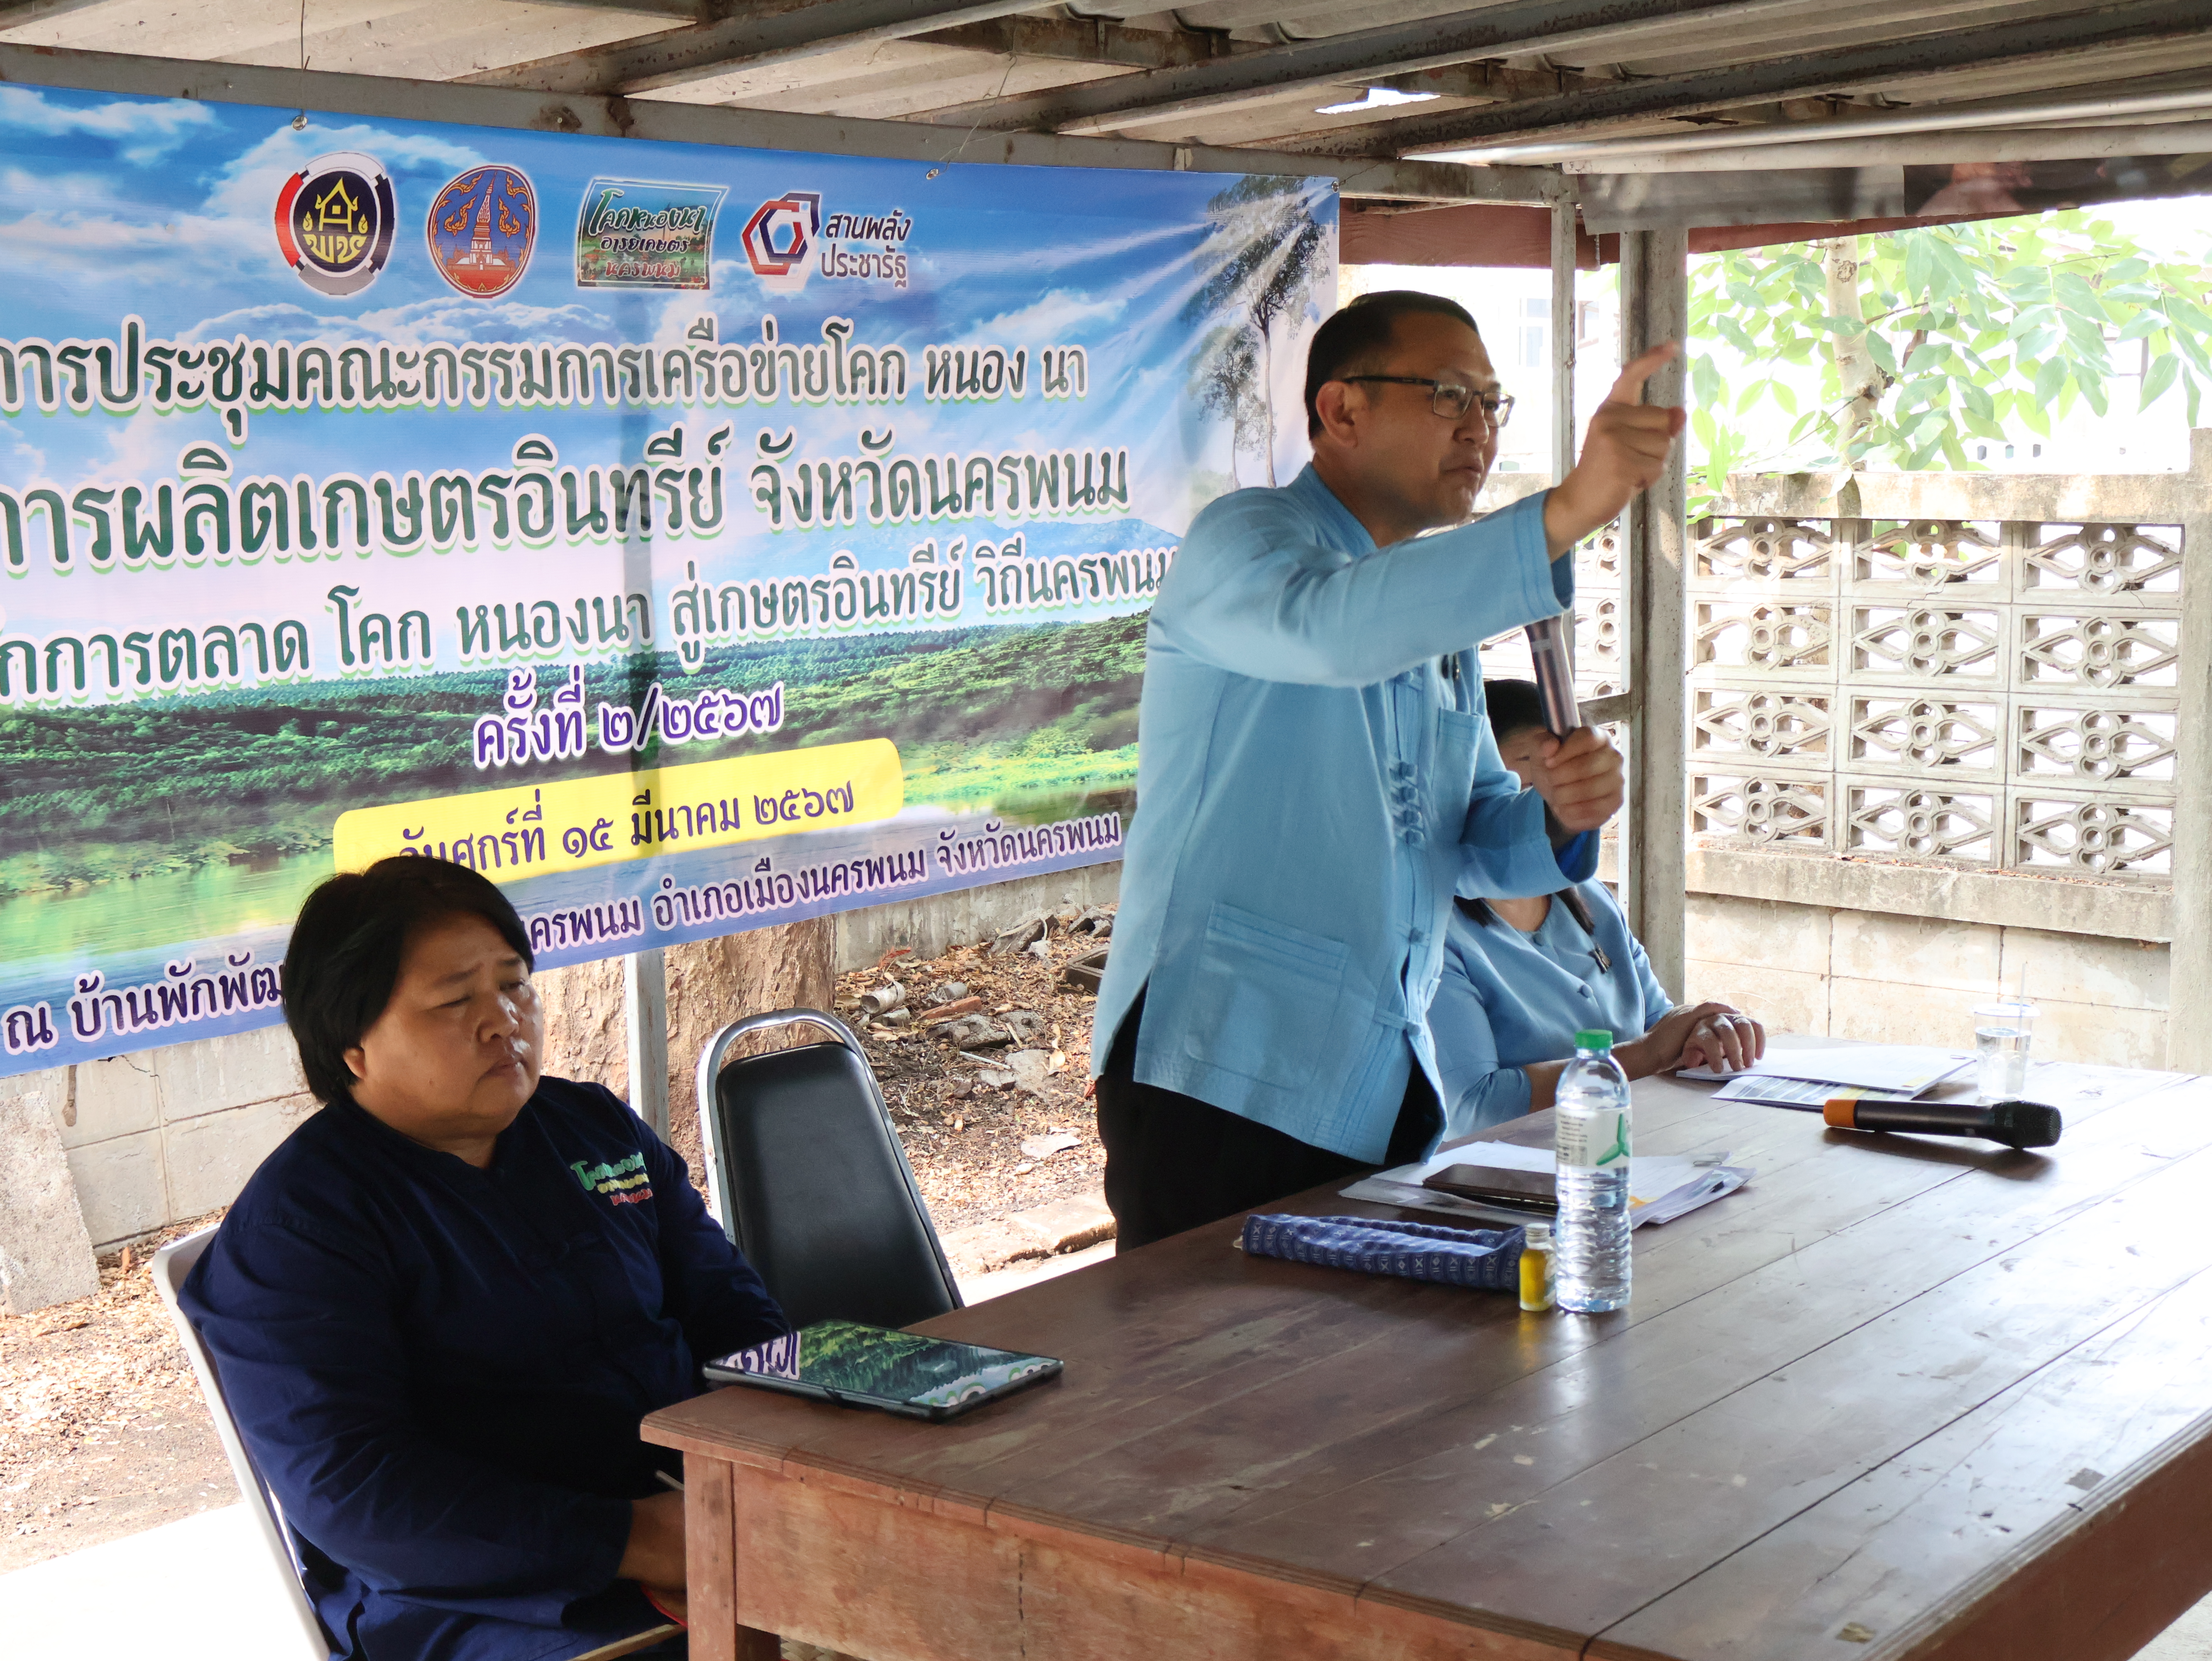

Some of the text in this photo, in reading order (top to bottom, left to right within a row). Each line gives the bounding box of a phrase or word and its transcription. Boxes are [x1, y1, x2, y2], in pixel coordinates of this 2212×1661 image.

[589, 189, 707, 235] โคกหนองนา
[826, 210, 911, 240] สานพลัง
[606, 262, 681, 277] นครพนม
[822, 243, 906, 287] ประชารัฐ
[927, 348, 1026, 395] หนอง
[1043, 347, 1084, 395] นา
[751, 429, 1127, 524] จังหวัดนครพนม
[328, 585, 430, 664] โคก
[457, 595, 651, 654] หนองนา
[675, 542, 963, 660] สู่เกษตรอินทรีย์
[477, 666, 781, 766] ครั้งที่ ๒/๒๕๖๗
[563, 818, 613, 857] ๑๕
[631, 789, 738, 847] มีนาคม
[754, 781, 854, 824] ๒๕๖๗
[6, 1007, 53, 1049] ณ
[522, 900, 640, 950] ครพนม
[655, 847, 925, 928] อำเภอเมืองนครพนม
[937, 812, 1120, 875] จังหวัดนครพนม
